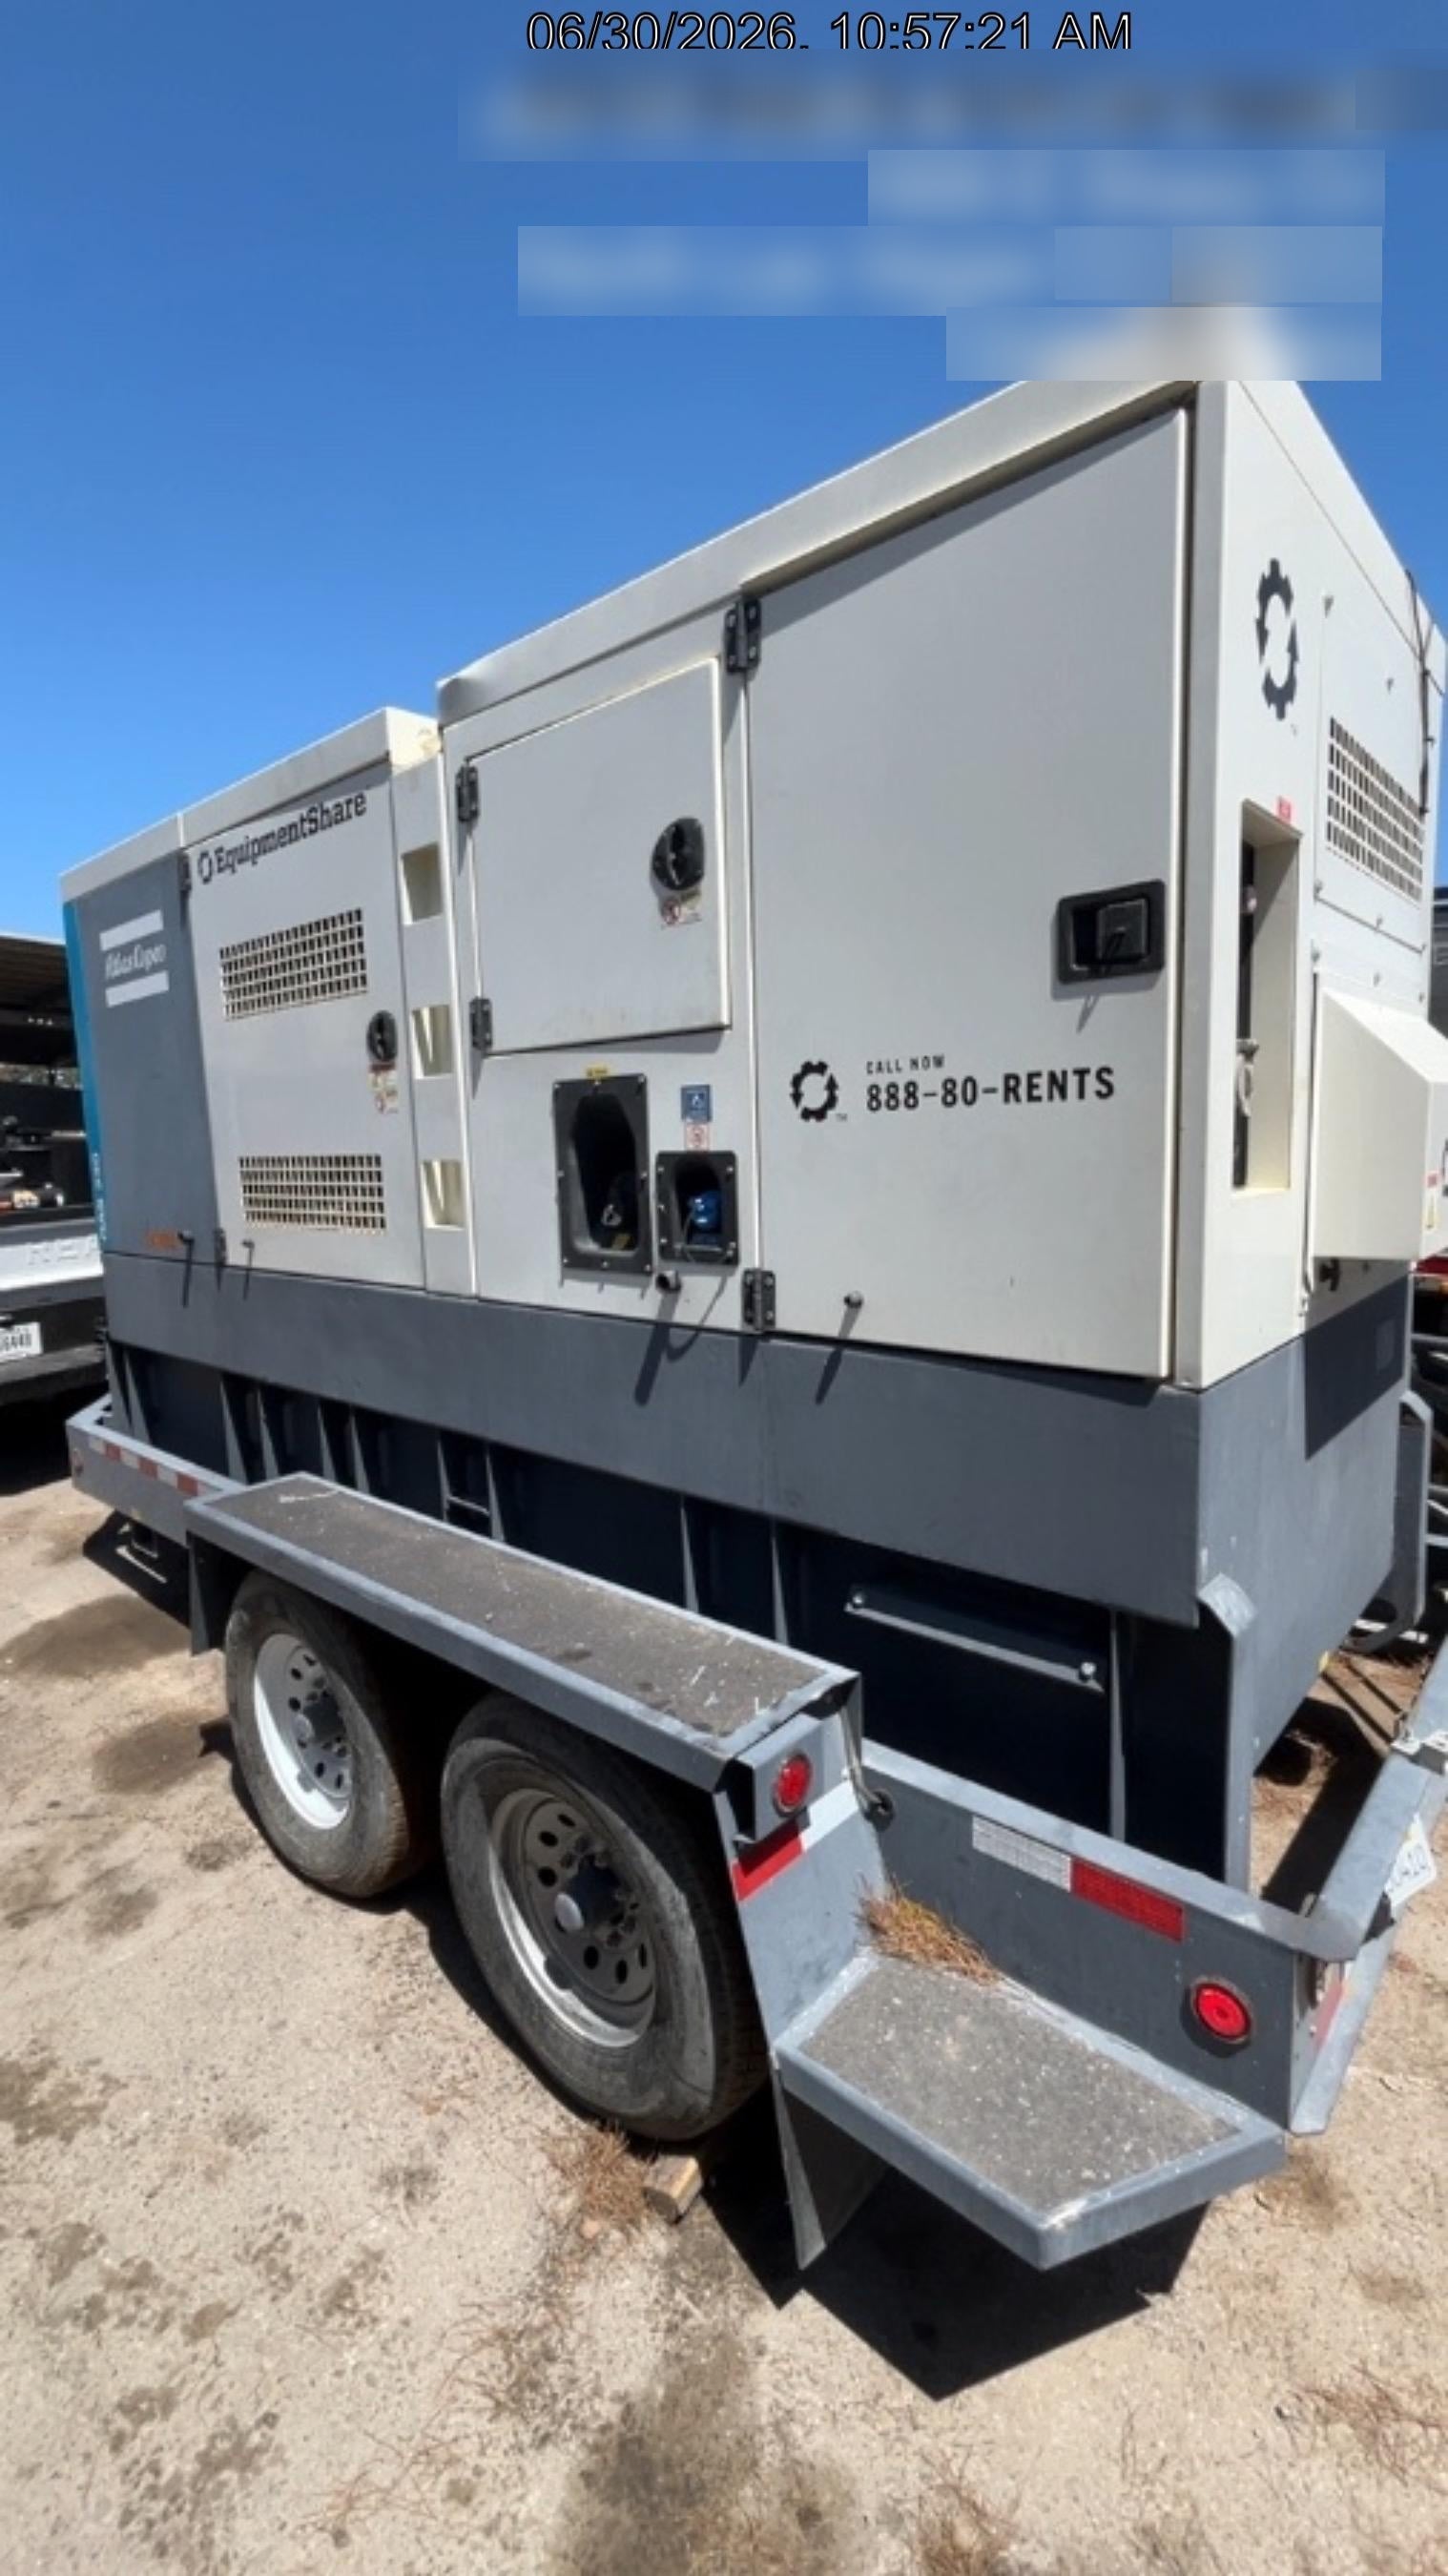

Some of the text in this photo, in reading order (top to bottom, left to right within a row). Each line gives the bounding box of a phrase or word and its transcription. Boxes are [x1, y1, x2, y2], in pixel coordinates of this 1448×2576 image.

[215, 791, 367, 875] EquipmentShare
[866, 1054, 944, 1075] CALL NOW
[866, 1066, 1115, 1112] 888-80-RENTS
